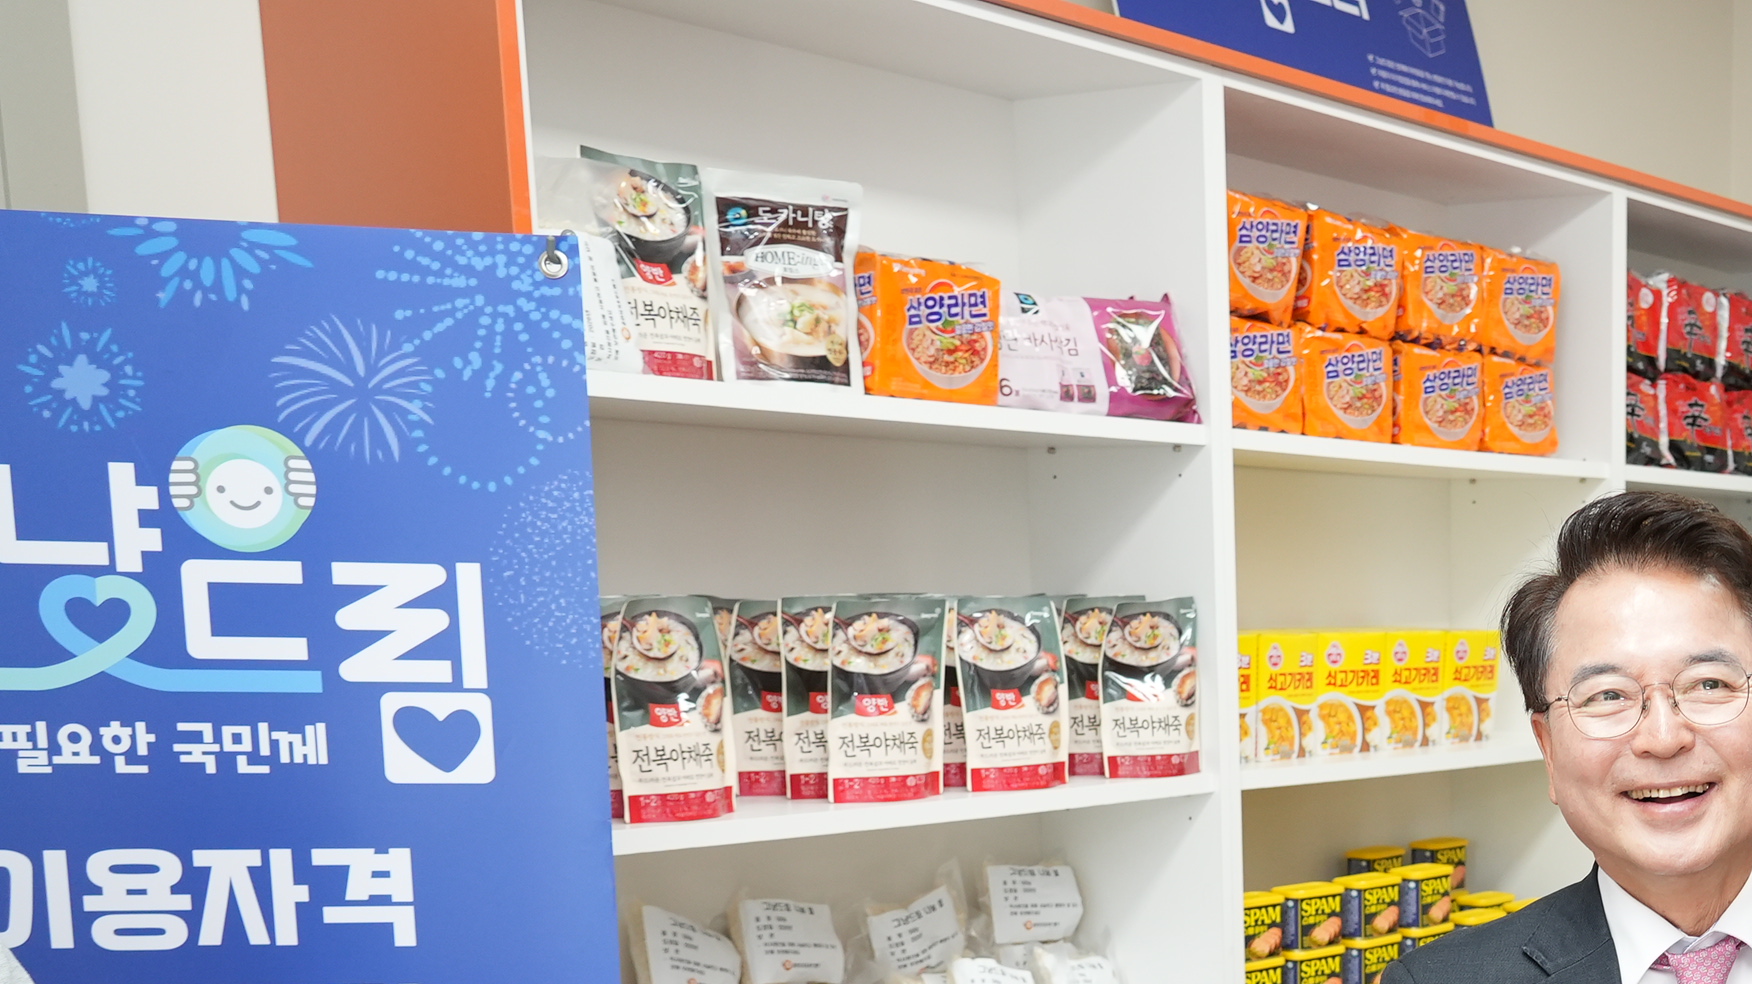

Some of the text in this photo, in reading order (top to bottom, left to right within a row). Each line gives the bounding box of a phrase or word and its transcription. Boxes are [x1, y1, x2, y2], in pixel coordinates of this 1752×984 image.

[1238, 221, 1298, 246] 삼양라면
[1336, 246, 1395, 269] 삼양라면
[1423, 252, 1476, 275] 삼양라면
[1503, 275, 1554, 297] 삼양라면
[906, 290, 989, 326] 삼양라면
[1324, 350, 1384, 380] 삼양라면
[1422, 365, 1480, 395] 삼양라면
[1502, 372, 1549, 401] 삼양라면
[976, 722, 1046, 749] 전복야채죽
[1112, 712, 1183, 739] 전복야채죽
[172, 721, 328, 774] 국민께
[838, 730, 918, 758] 전복야채죽
[631, 741, 714, 774] 전복야채죽
[1437, 847, 1466, 863] SPAM
[1365, 885, 1399, 905] SPAM
[1420, 876, 1451, 895] SPAM
[1301, 895, 1341, 917] SPAM
[1365, 943, 1399, 964] SPAM
[1300, 956, 1341, 978] SPAM
